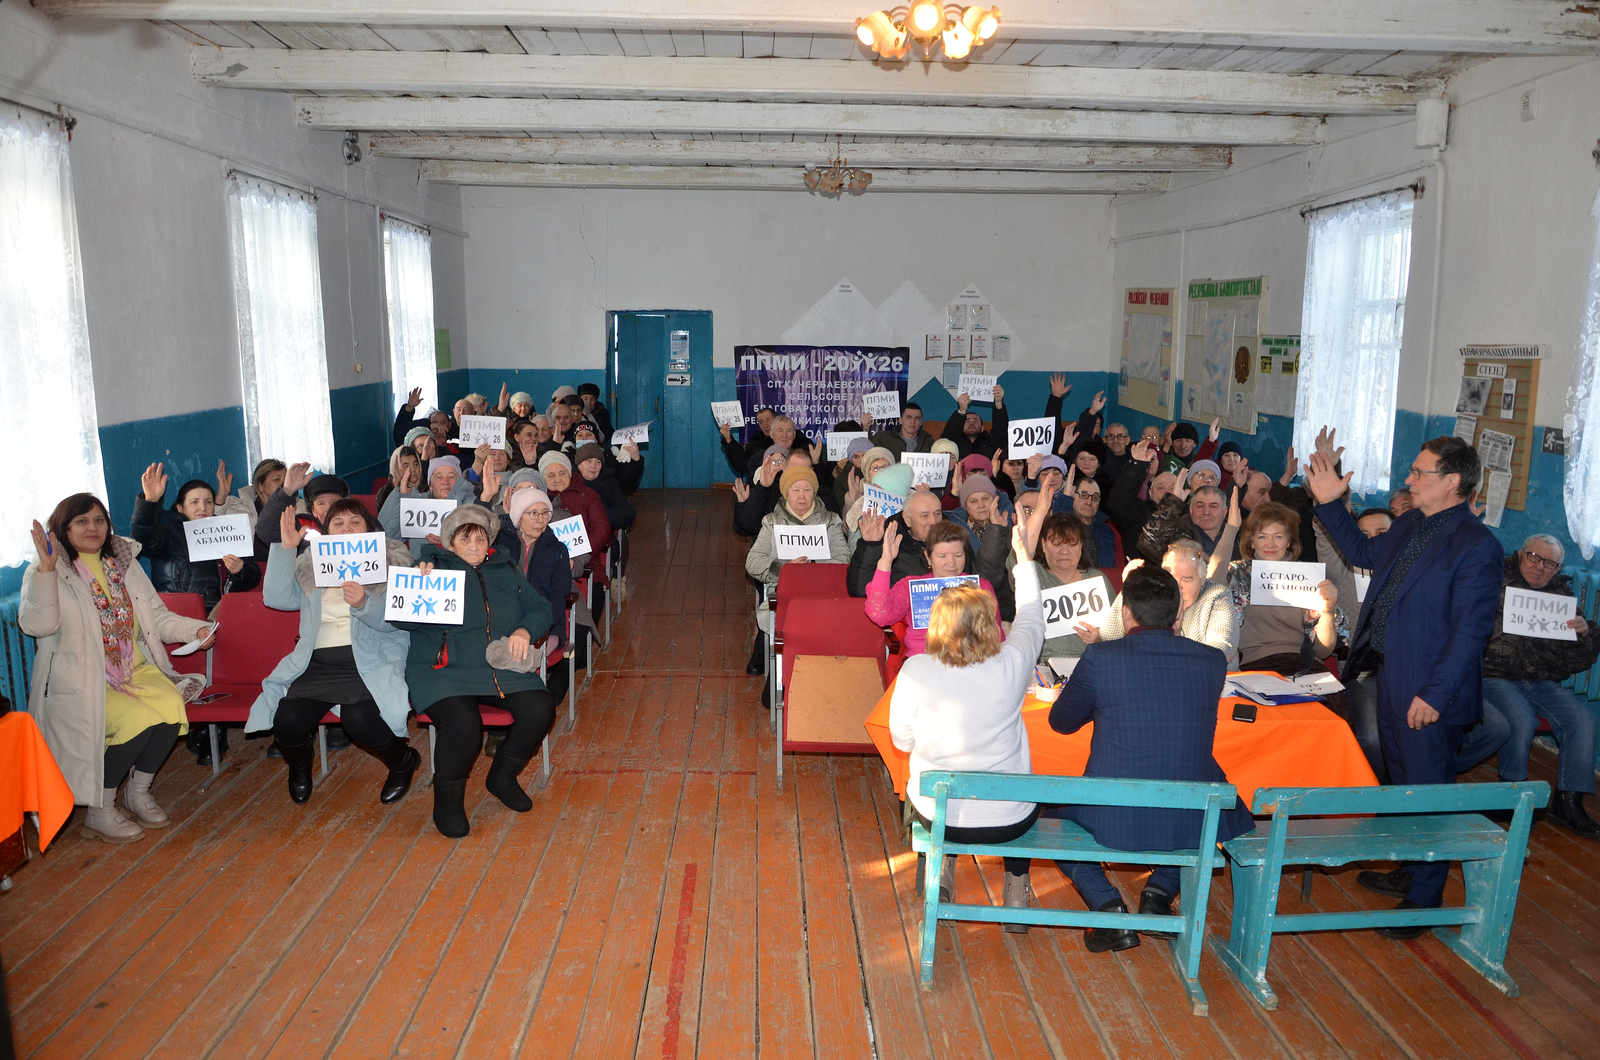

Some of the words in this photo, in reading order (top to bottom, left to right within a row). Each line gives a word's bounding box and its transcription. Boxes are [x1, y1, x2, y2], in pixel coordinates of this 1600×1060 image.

[1459, 345, 1539, 357] ИНФОРМАЦИОННЫЙ
[741, 355, 806, 372] ППМИ
[824, 355, 850, 372] 20
[878, 356, 904, 372] 26
[1479, 365, 1506, 376] СТЕНД
[767, 381, 780, 389] СП
[784, 379, 877, 389] КУЧЕРБАЕВСКИЙ
[962, 377, 993, 386] ППМИ
[789, 392, 855, 401] СЕЛЬСОВЕТ
[983, 388, 992, 396] 26
[866, 394, 896, 404] ППМИ
[714, 405, 738, 414] ППМИ
[888, 404, 897, 412] 26
[464, 420, 501, 431] ППМИ
[462, 433, 471, 442] 20
[493, 434, 501, 444] 26
[1012, 424, 1053, 448] 2026
[829, 448, 838, 456] 20
[906, 457, 945, 468] ППМИ
[933, 472, 944, 480] 26
[868, 499, 879, 509] 20
[195, 534, 246, 546] АБЗАНОВО
[572, 535, 584, 547] 26
[780, 534, 825, 547] ППМИ
[318, 539, 378, 556] ППМИ
[320, 562, 334, 574] 20
[363, 559, 379, 572] 26
[394, 573, 457, 592] ППМИ
[911, 583, 939, 593] ППМИ
[1259, 582, 1317, 593] АБЗАНОВО
[391, 595, 405, 609] 20
[444, 598, 457, 613] 26
[1042, 587, 1104, 624] 2026
[1511, 594, 1569, 616] ППМИ
[1510, 613, 1524, 625] 20
[1552, 620, 1567, 632] 26
